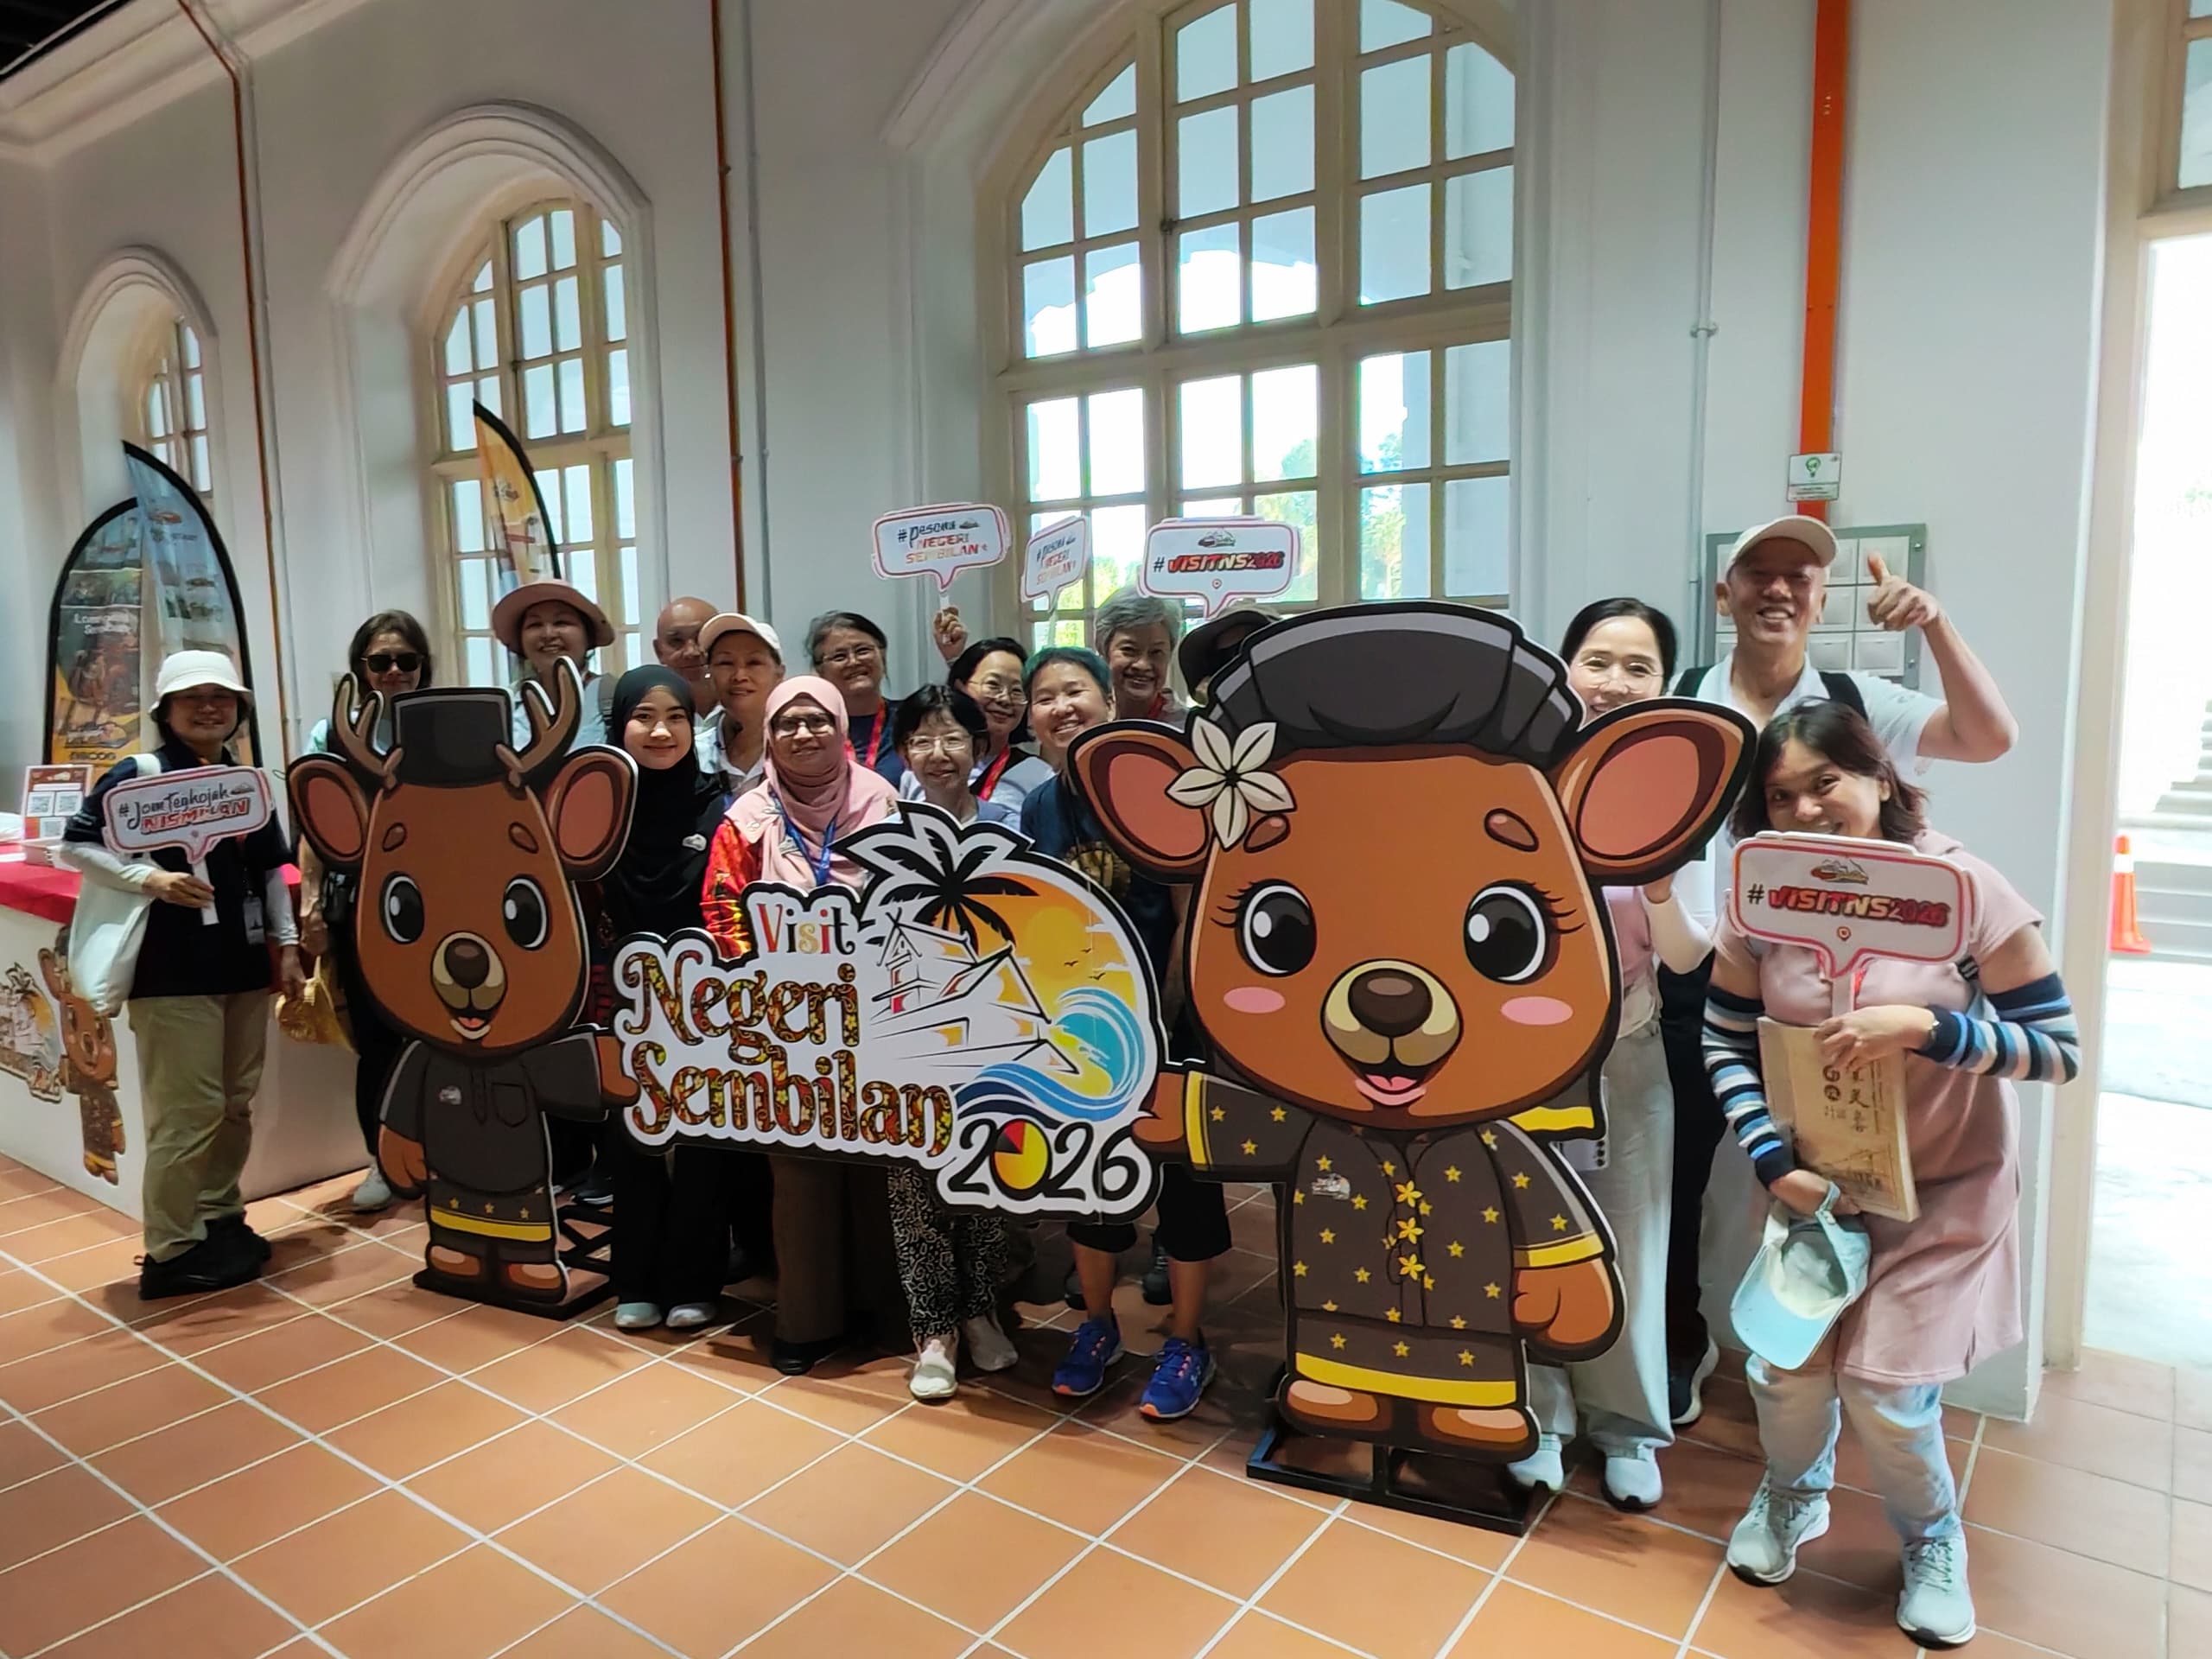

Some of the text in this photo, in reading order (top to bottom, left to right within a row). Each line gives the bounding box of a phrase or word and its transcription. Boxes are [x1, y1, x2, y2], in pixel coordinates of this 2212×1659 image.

[756, 902, 855, 956] Visit
[621, 949, 861, 1065] Negeri
[631, 1040, 954, 1156] Sembilan
[947, 1117, 1141, 1201] 2026
